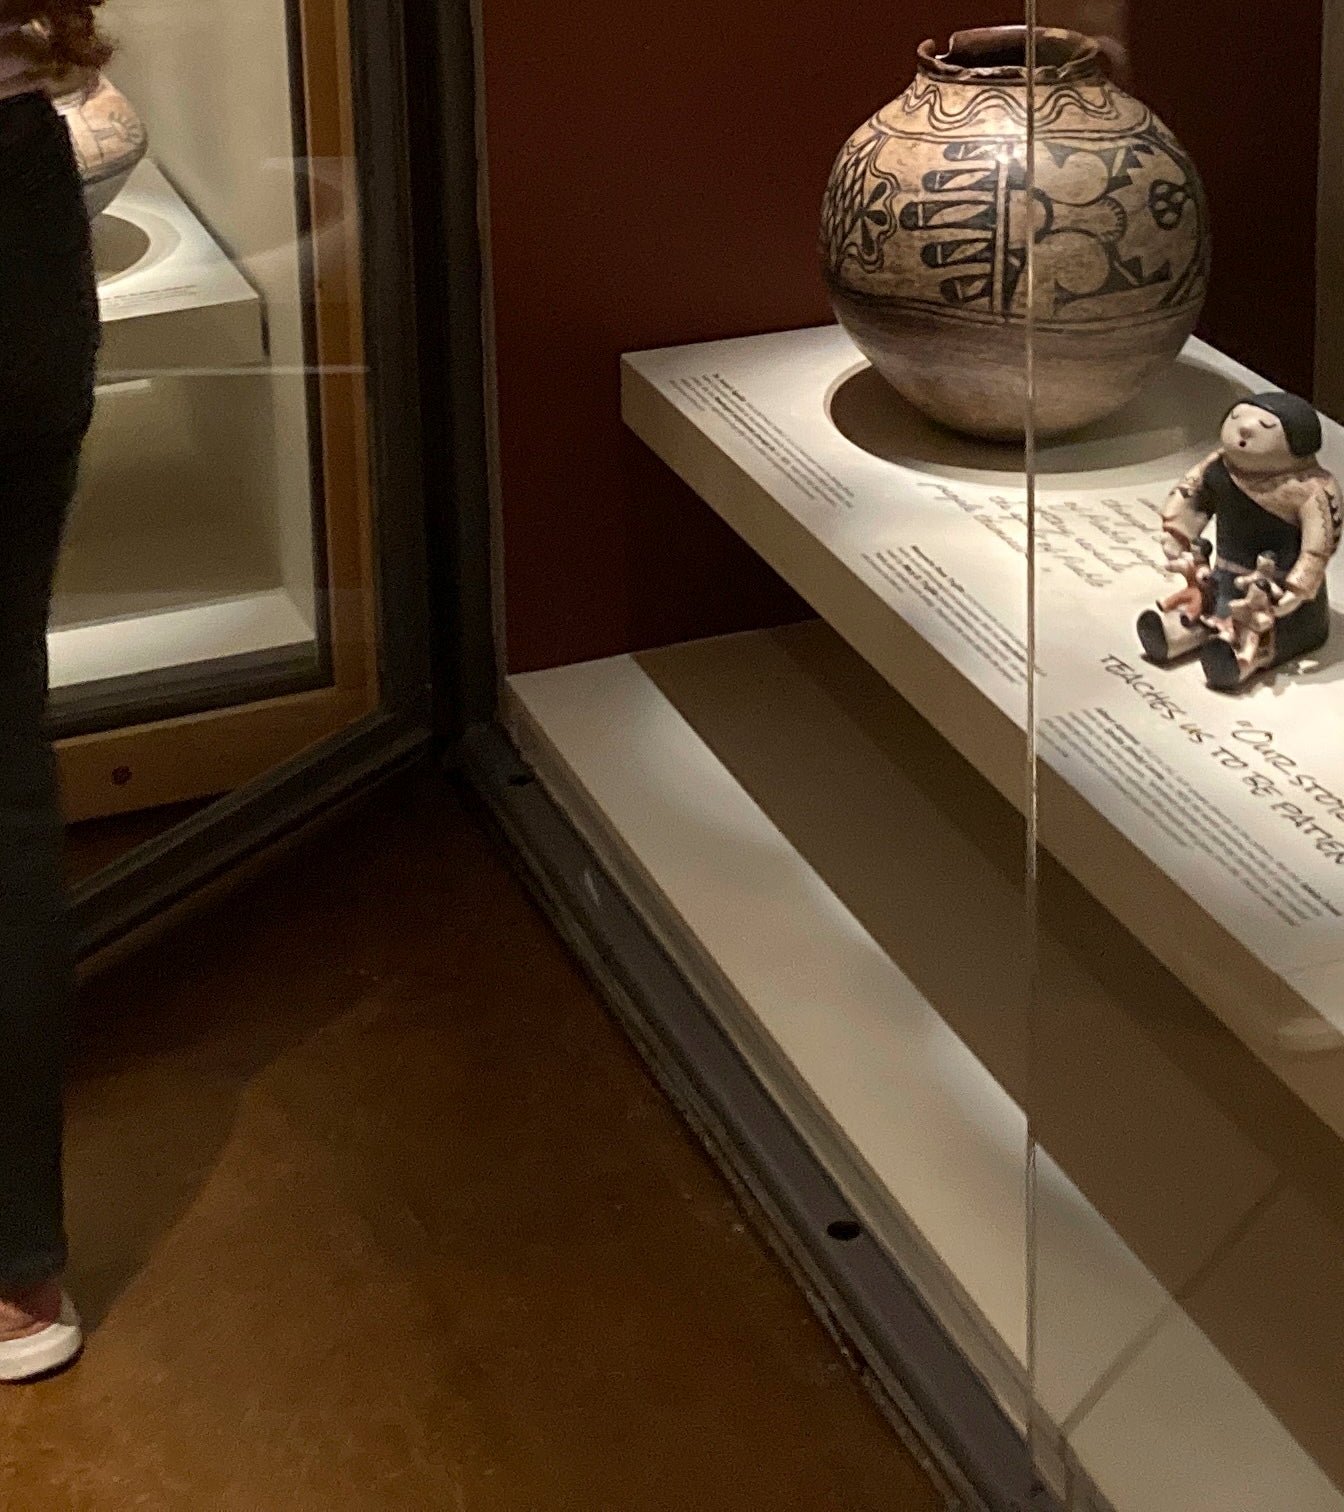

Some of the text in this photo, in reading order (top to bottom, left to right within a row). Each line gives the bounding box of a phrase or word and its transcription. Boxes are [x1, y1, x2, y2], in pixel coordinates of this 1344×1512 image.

[1101, 654, 1186, 720] TEACHES
[1179, 723, 1214, 744] US
[1211, 746, 1249, 769] TO
[1243, 771, 1283, 798] BE
